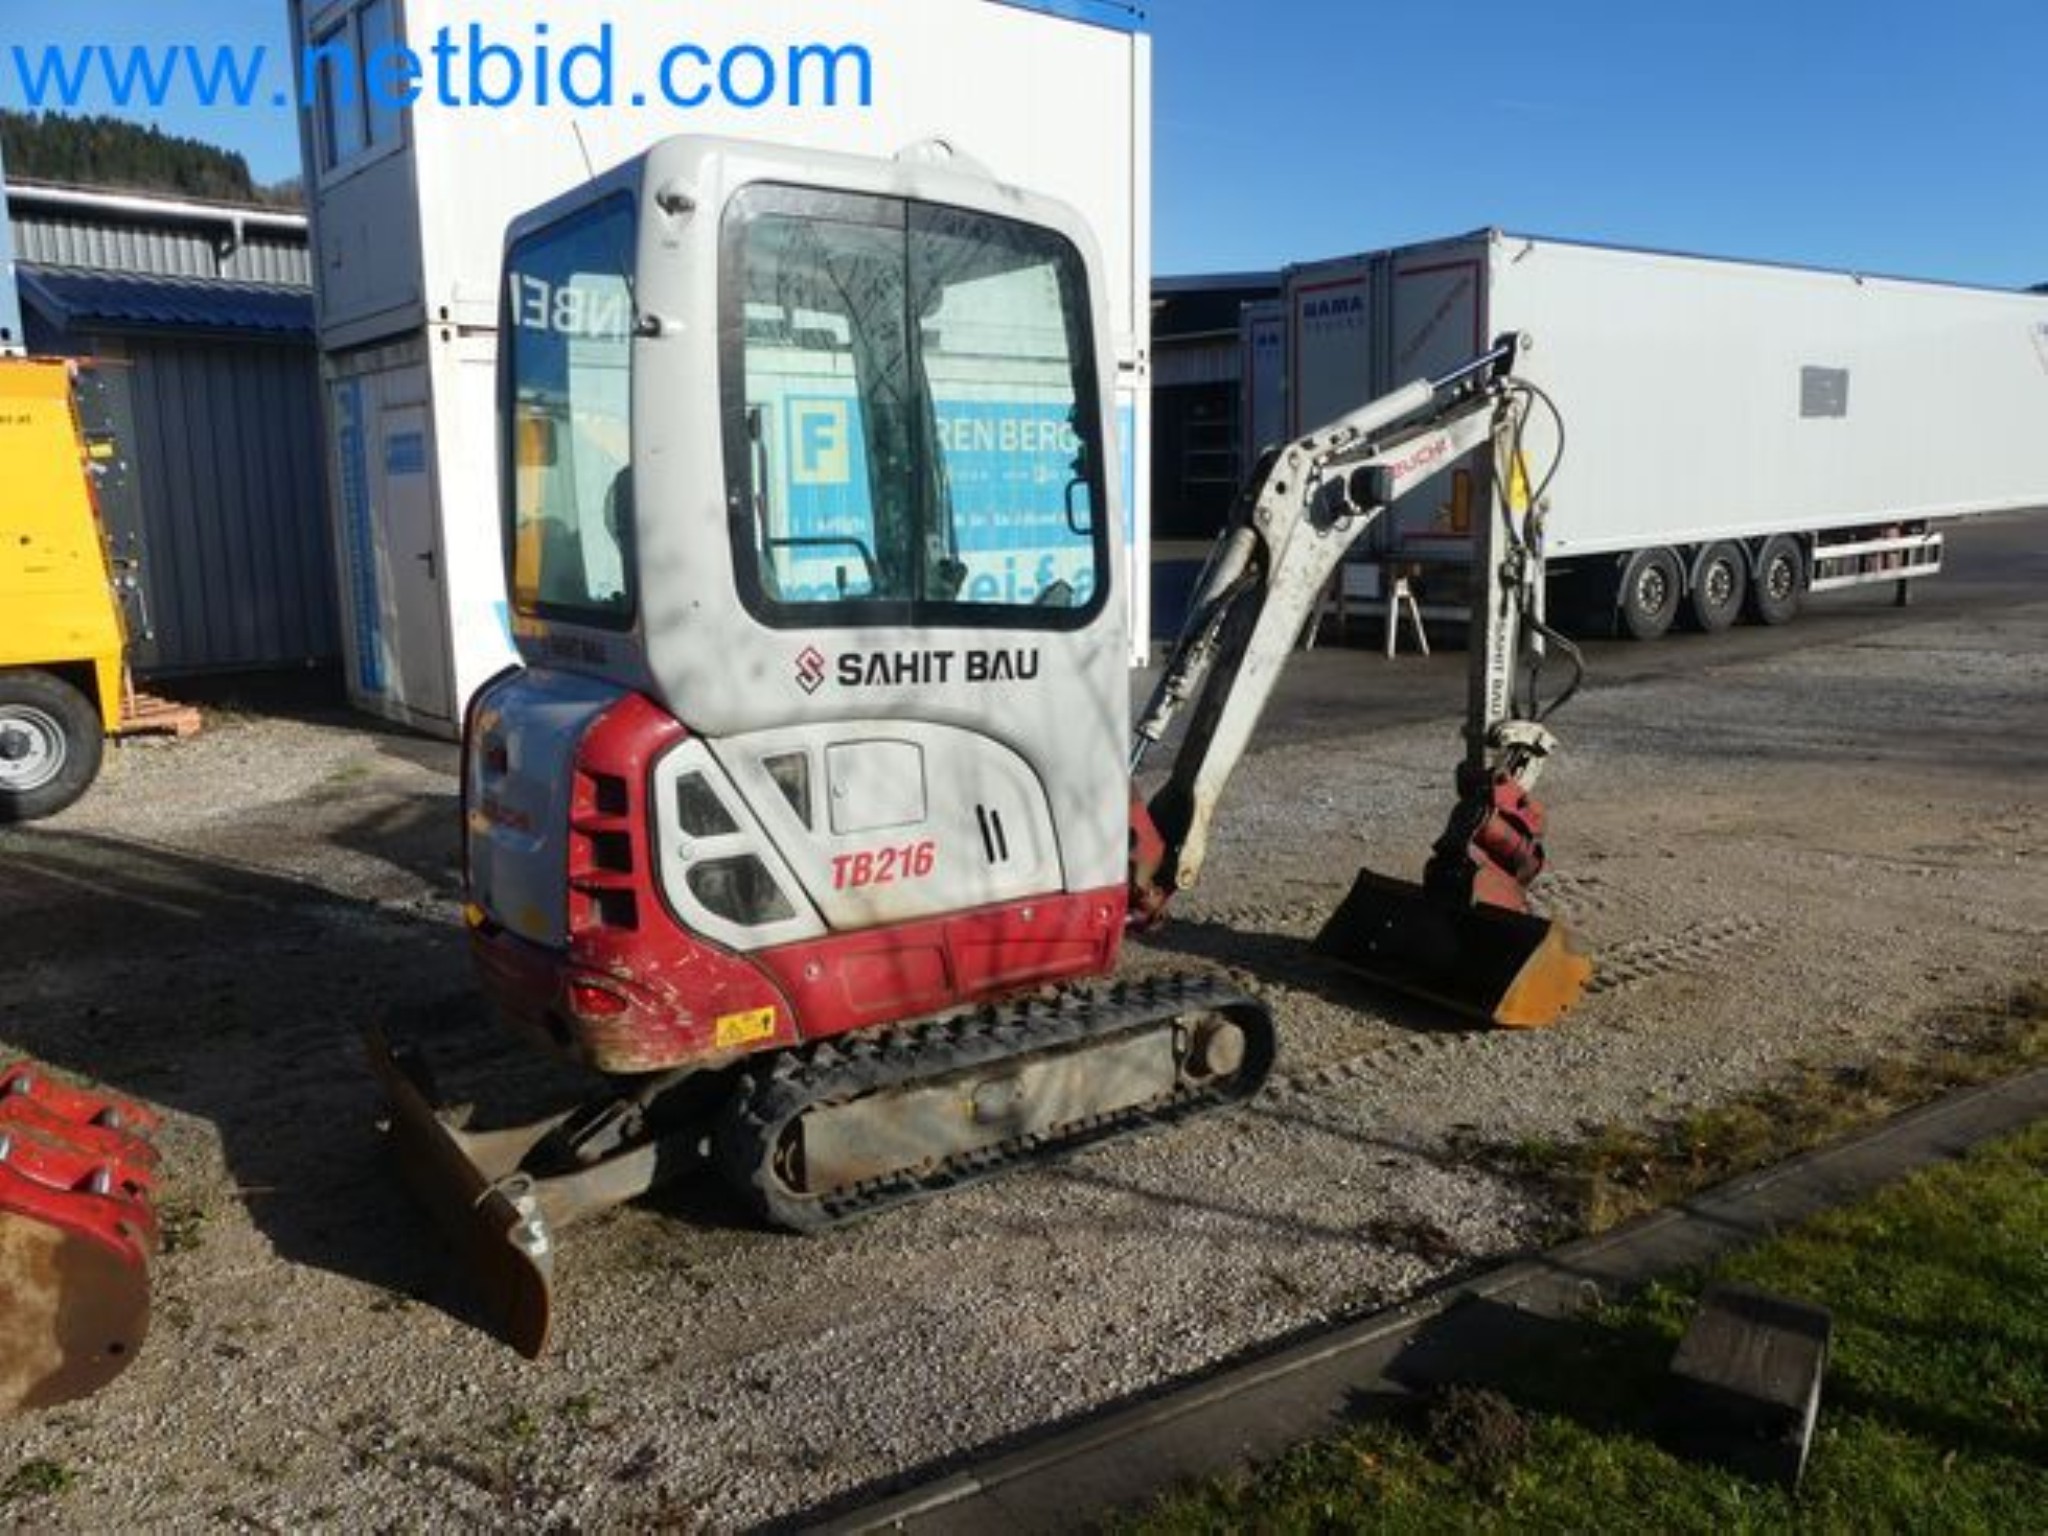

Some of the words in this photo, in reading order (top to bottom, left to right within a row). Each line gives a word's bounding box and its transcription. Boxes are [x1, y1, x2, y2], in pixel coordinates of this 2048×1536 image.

[837, 652, 954, 686] SAHIT
[965, 649, 1039, 682] BAU
[831, 841, 936, 890] TB216
